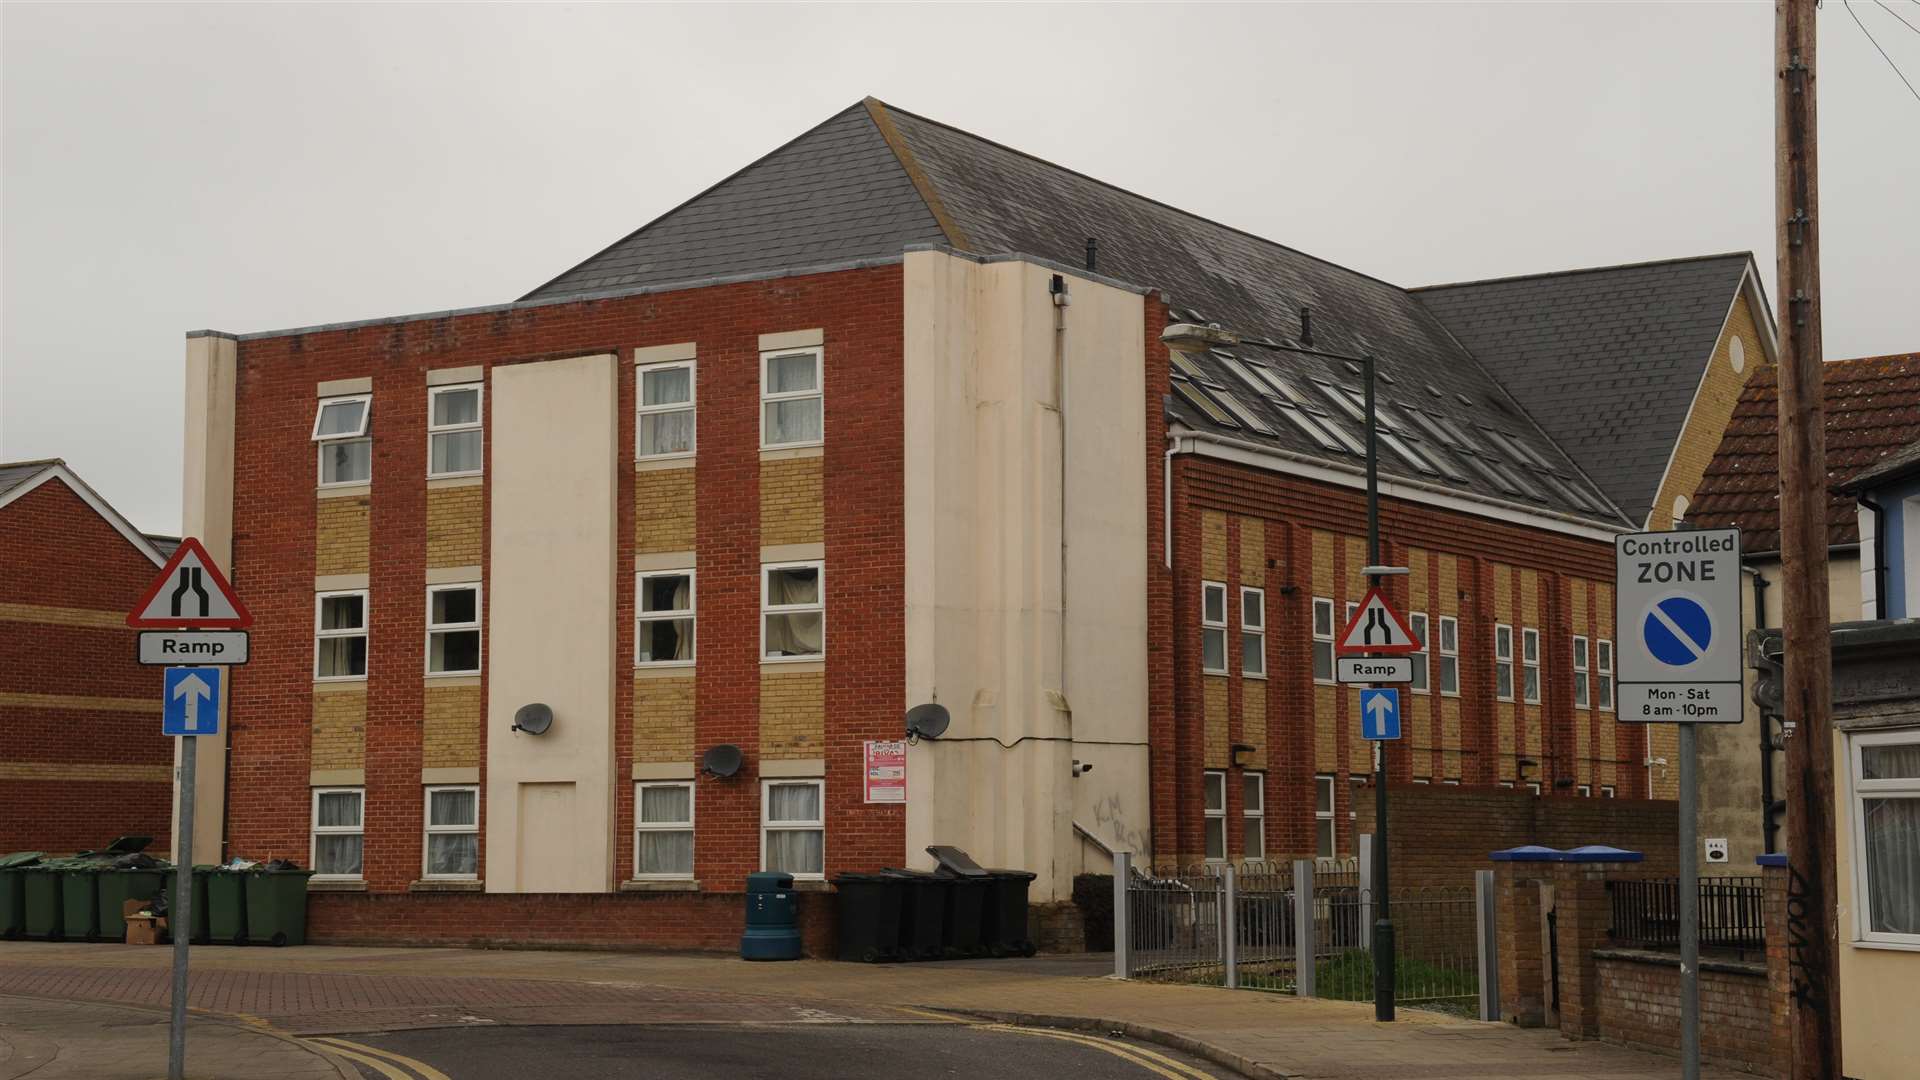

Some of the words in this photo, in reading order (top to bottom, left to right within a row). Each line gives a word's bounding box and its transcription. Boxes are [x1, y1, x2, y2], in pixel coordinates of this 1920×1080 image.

[1623, 534, 1734, 556] Controlled
[1638, 560, 1716, 583] ZONE
[162, 639, 225, 656] Ramp
[1353, 663, 1396, 677] Ramp
[1648, 688, 1676, 700] Mon
[1687, 688, 1711, 700] Sat
[1642, 704, 1651, 715] 8
